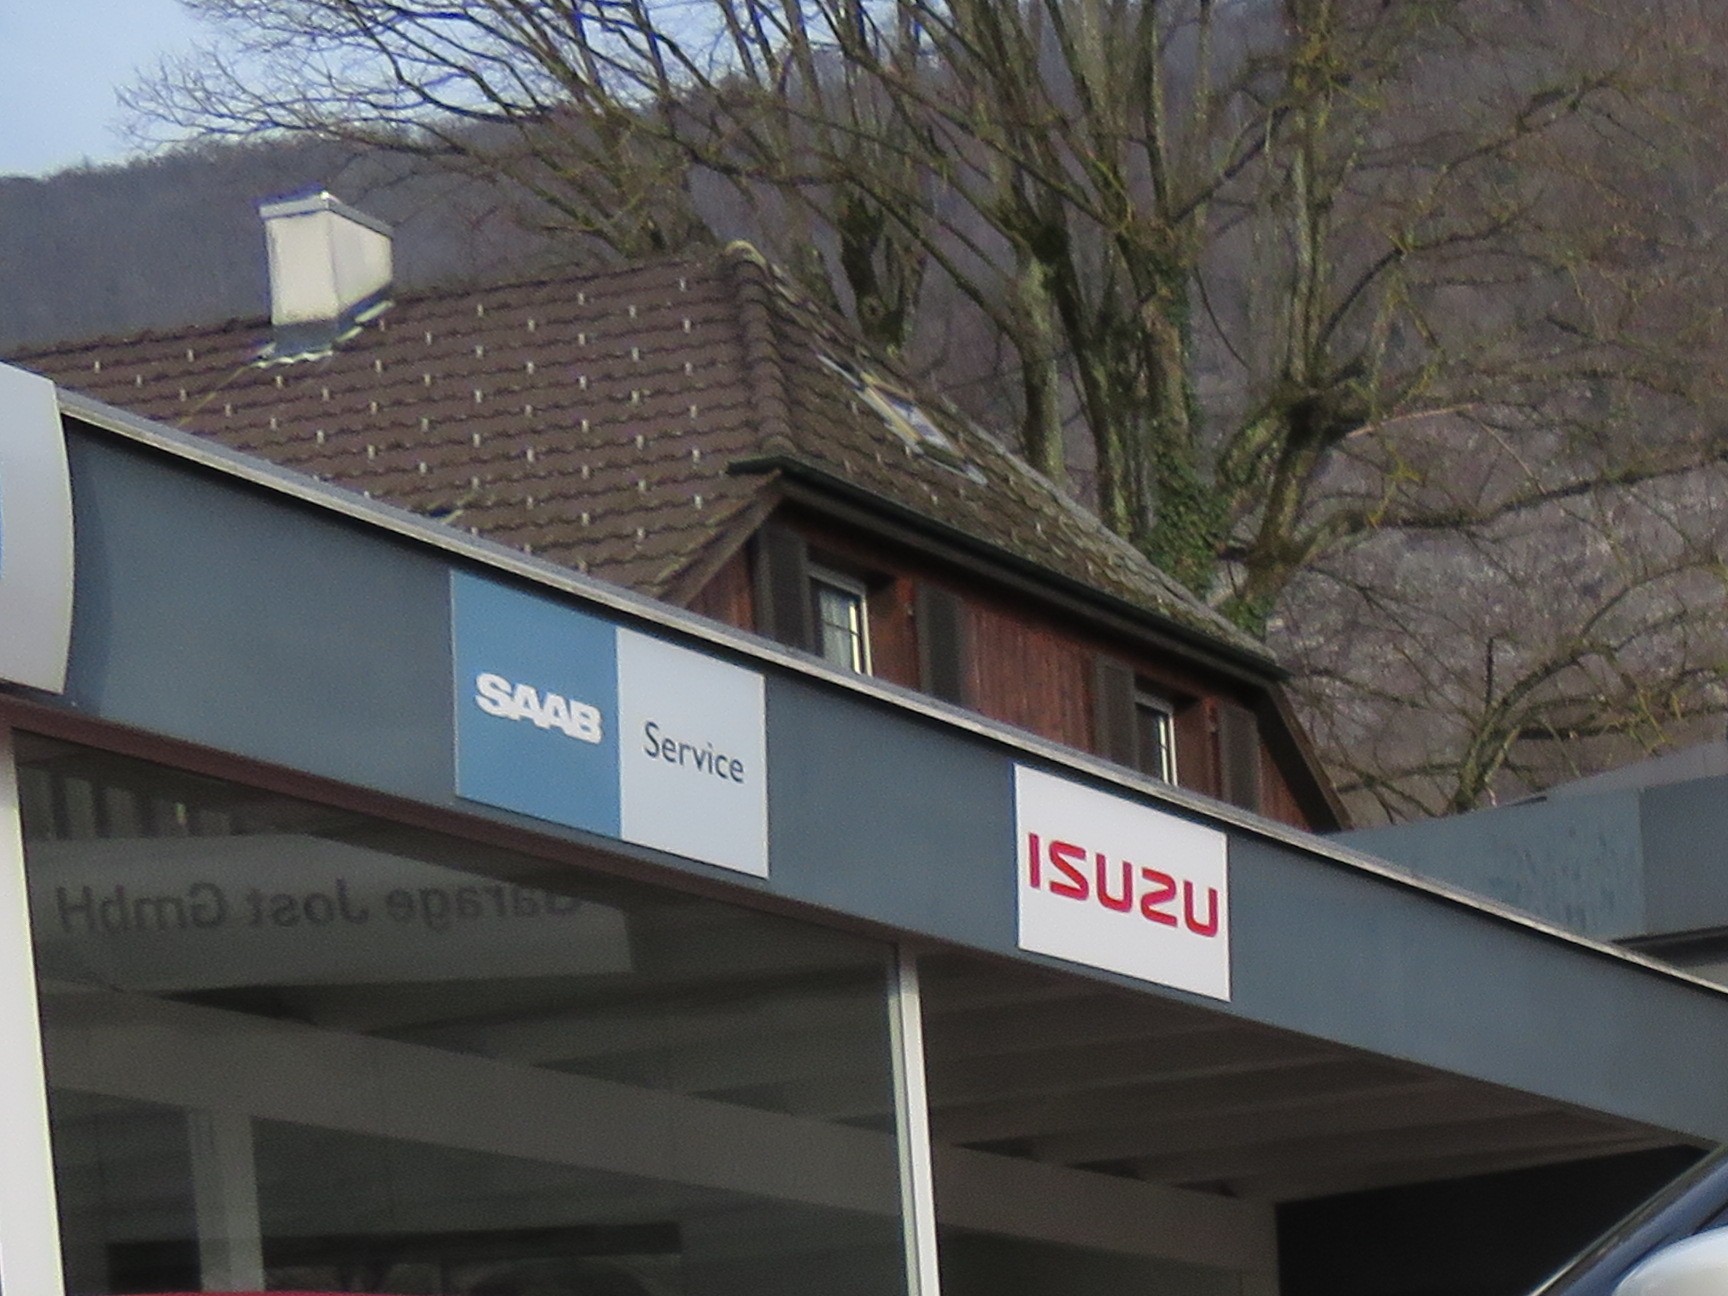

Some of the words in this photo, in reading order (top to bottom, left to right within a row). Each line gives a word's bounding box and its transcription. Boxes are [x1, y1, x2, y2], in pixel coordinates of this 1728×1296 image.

[475, 672, 603, 745] SAAB
[643, 720, 745, 784] Service
[1028, 832, 1219, 938] ISUZU
